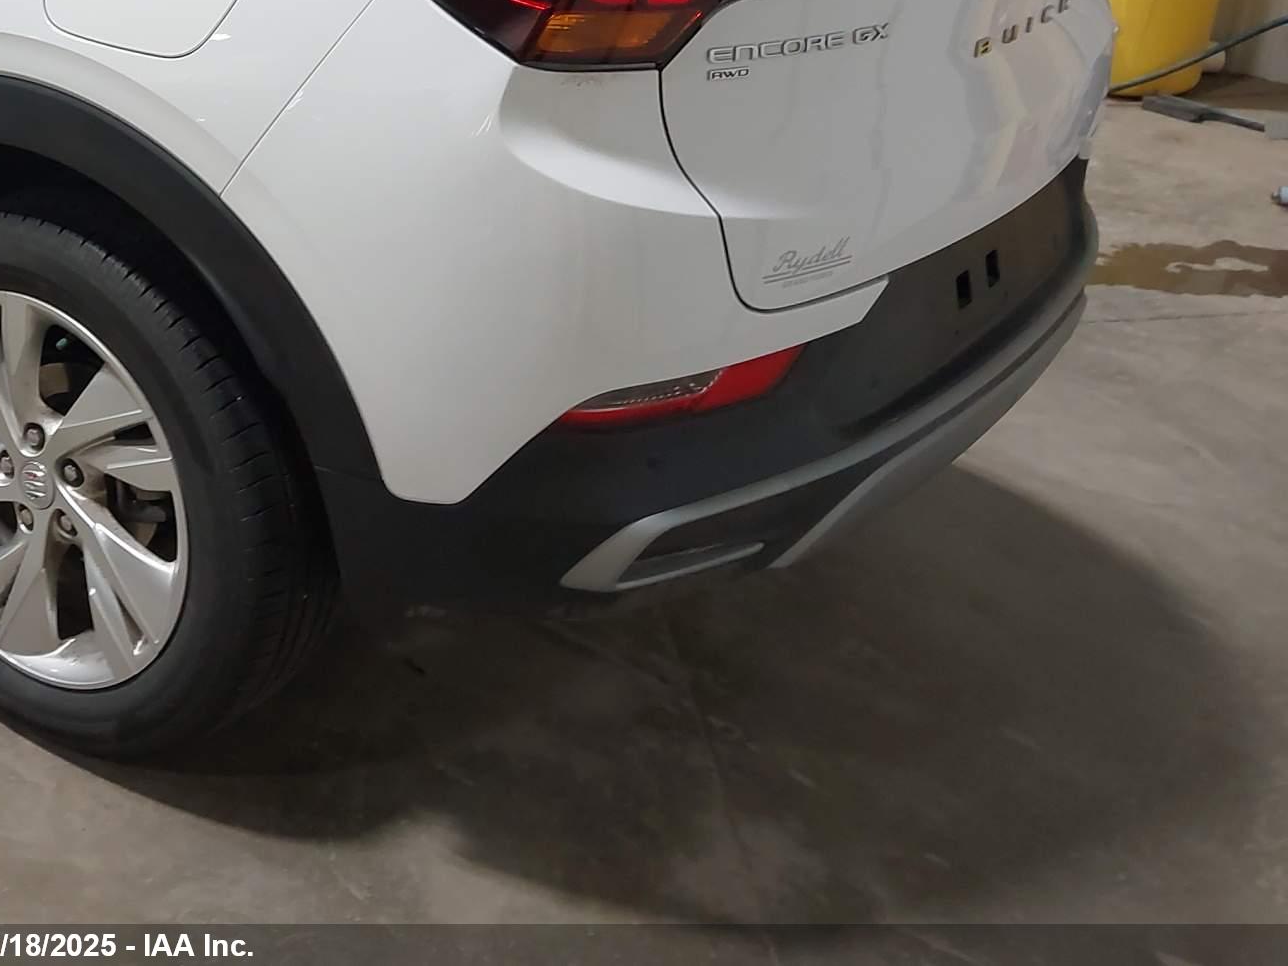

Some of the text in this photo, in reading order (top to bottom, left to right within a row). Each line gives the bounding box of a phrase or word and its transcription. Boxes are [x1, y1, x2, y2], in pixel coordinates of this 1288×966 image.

[707, 22, 889, 64] ENCORE GX
[708, 66, 750, 81] AWD
